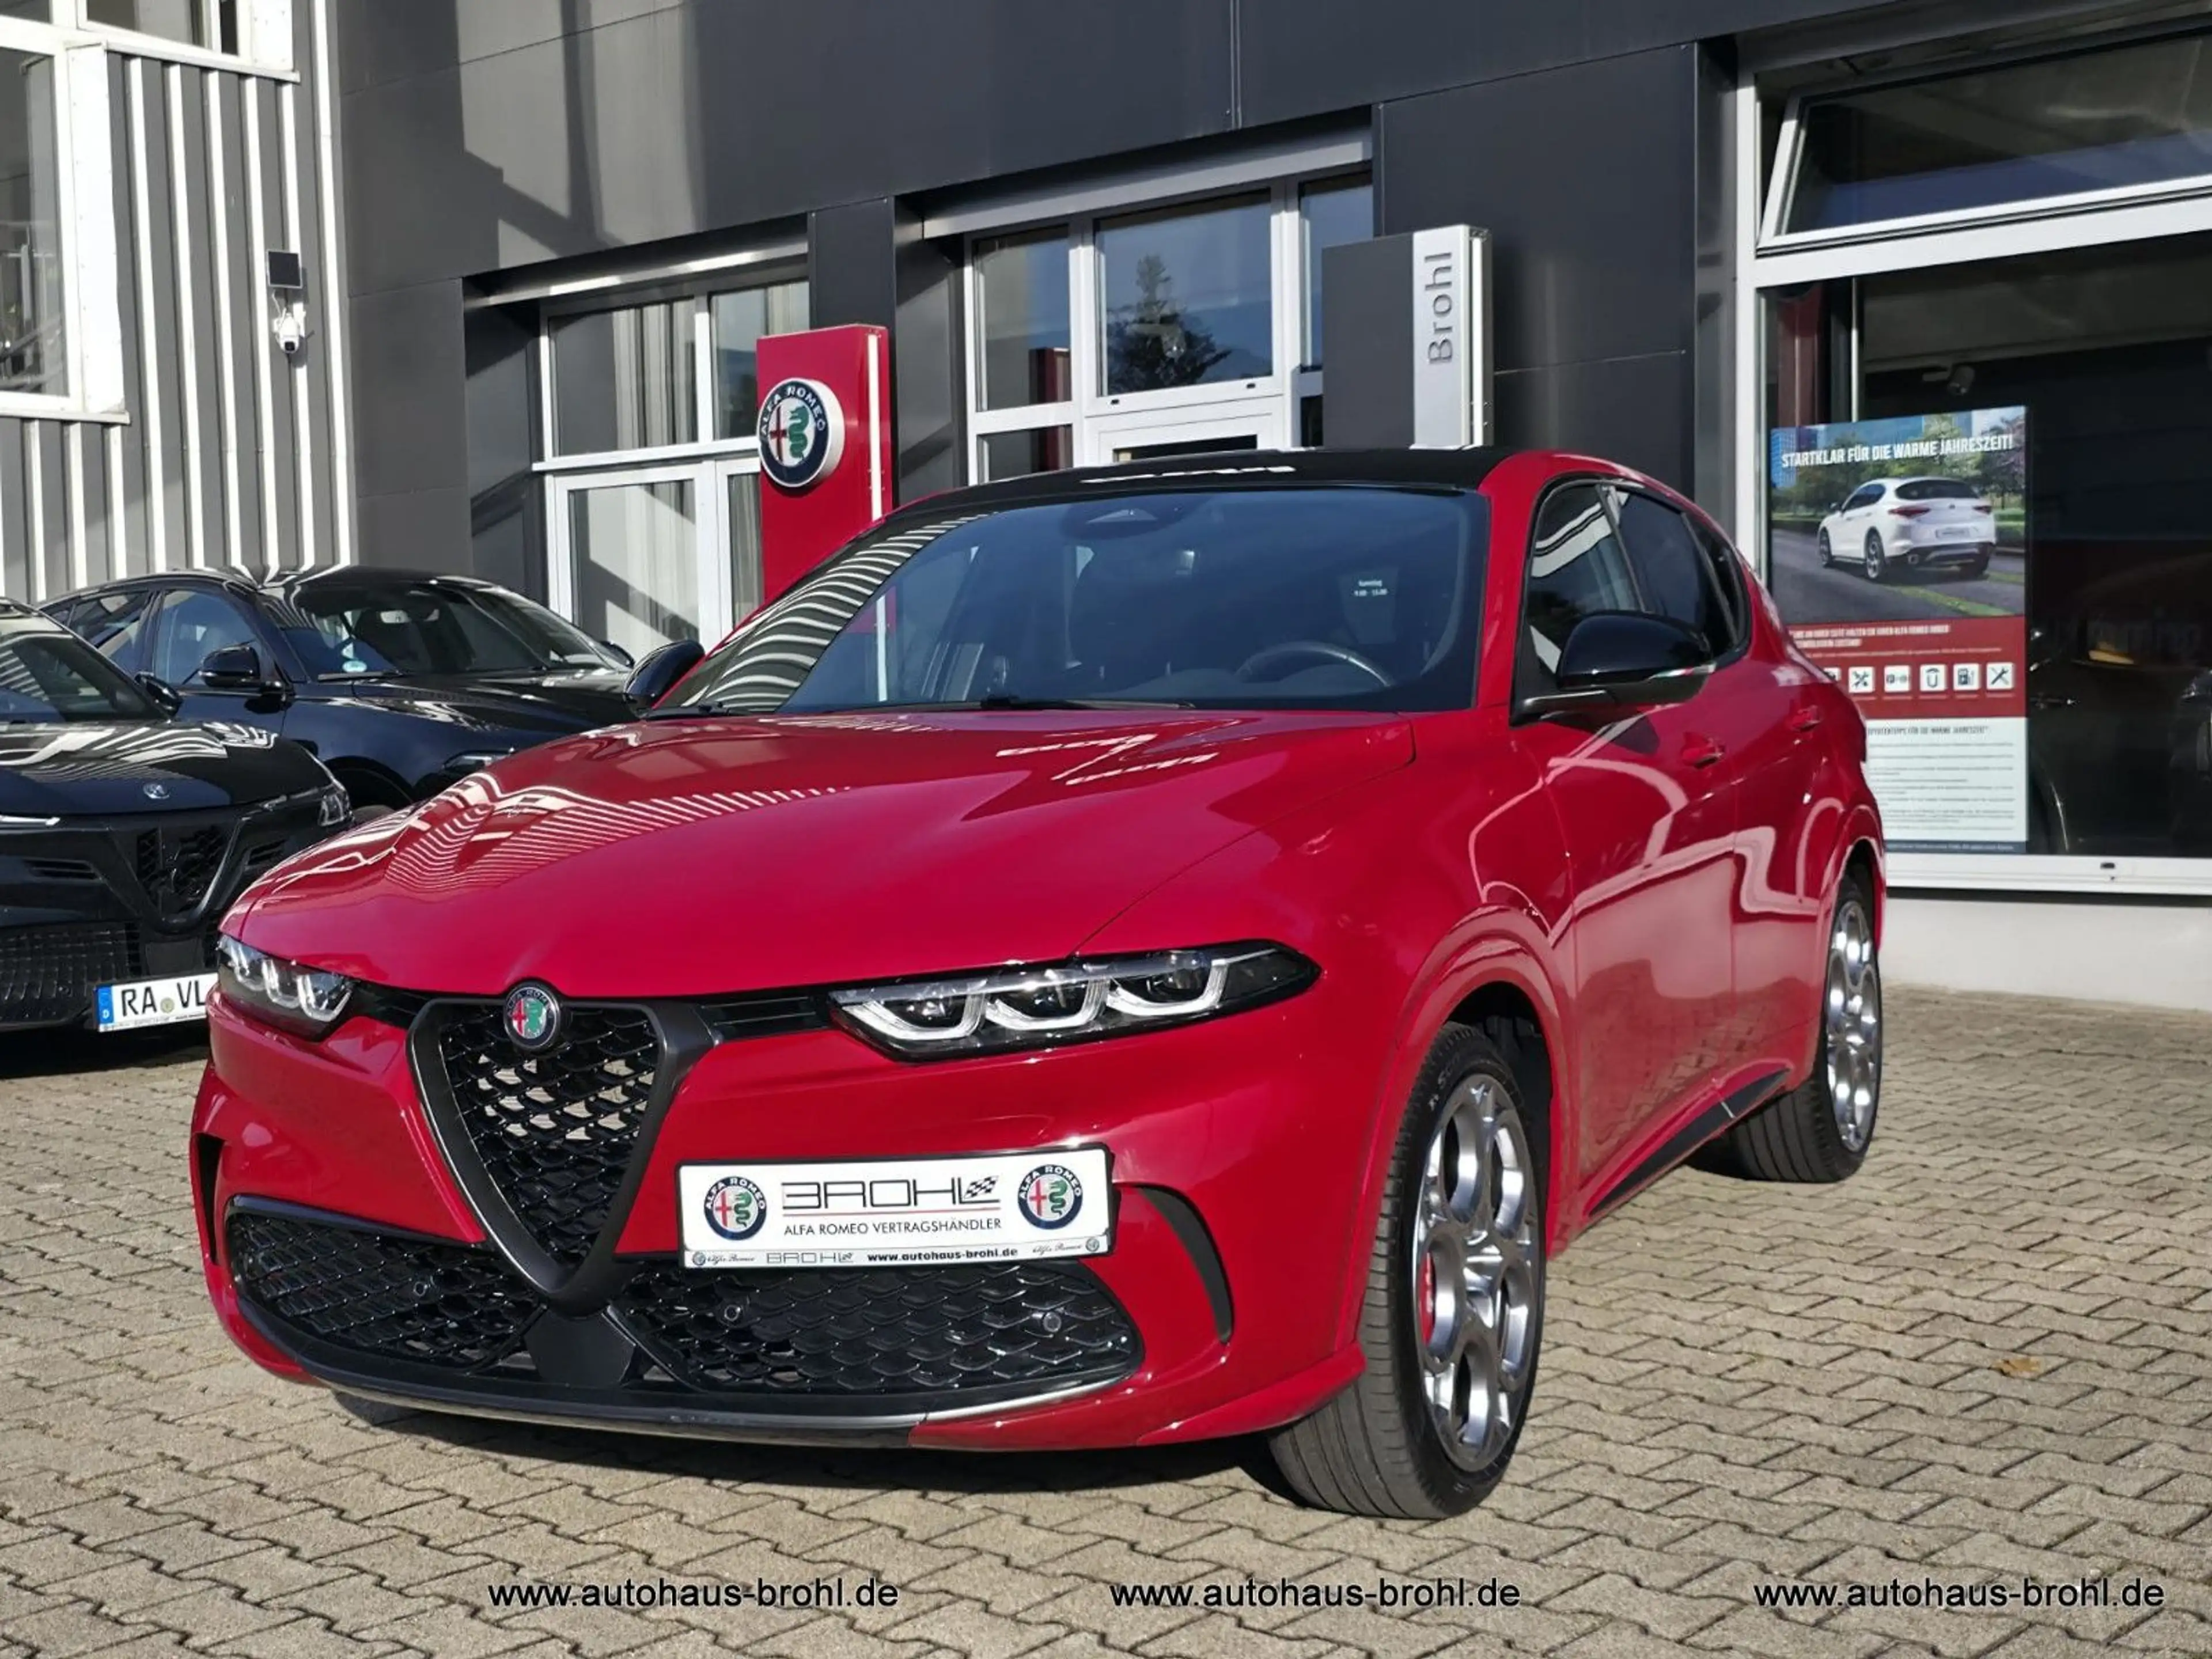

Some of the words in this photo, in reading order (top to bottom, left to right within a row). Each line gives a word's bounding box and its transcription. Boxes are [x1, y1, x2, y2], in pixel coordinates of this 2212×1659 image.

[1425, 252, 1453, 365] Brohl
[760, 393, 781, 435] ALFA
[786, 385, 825, 431] ROMEO
[1781, 448, 1846, 468] STARTKLAR
[1848, 444, 1869, 463] FÜR
[1872, 444, 1891, 460] DIE
[1893, 441, 1940, 459] WARME
[1940, 434, 2013, 455] JAHRESZEIT!
[121, 986, 157, 1017] RA
[176, 980, 206, 1008] VL
[706, 1181, 726, 1210] ALFA
[730, 1177, 766, 1210] ROMEO
[781, 1176, 1001, 1210] BROHL
[1019, 1171, 1040, 1200] ALFA
[1045, 1166, 1082, 1197] ROMEO
[784, 1221, 815, 1236] ALFA
[820, 1220, 869, 1234] ROMEO
[872, 1218, 1002, 1233] VERTRAGSHÄNDLER
[767, 1251, 854, 1264] BROHL
[868, 1248, 1018, 1263] www.autohaus-brohl.de
